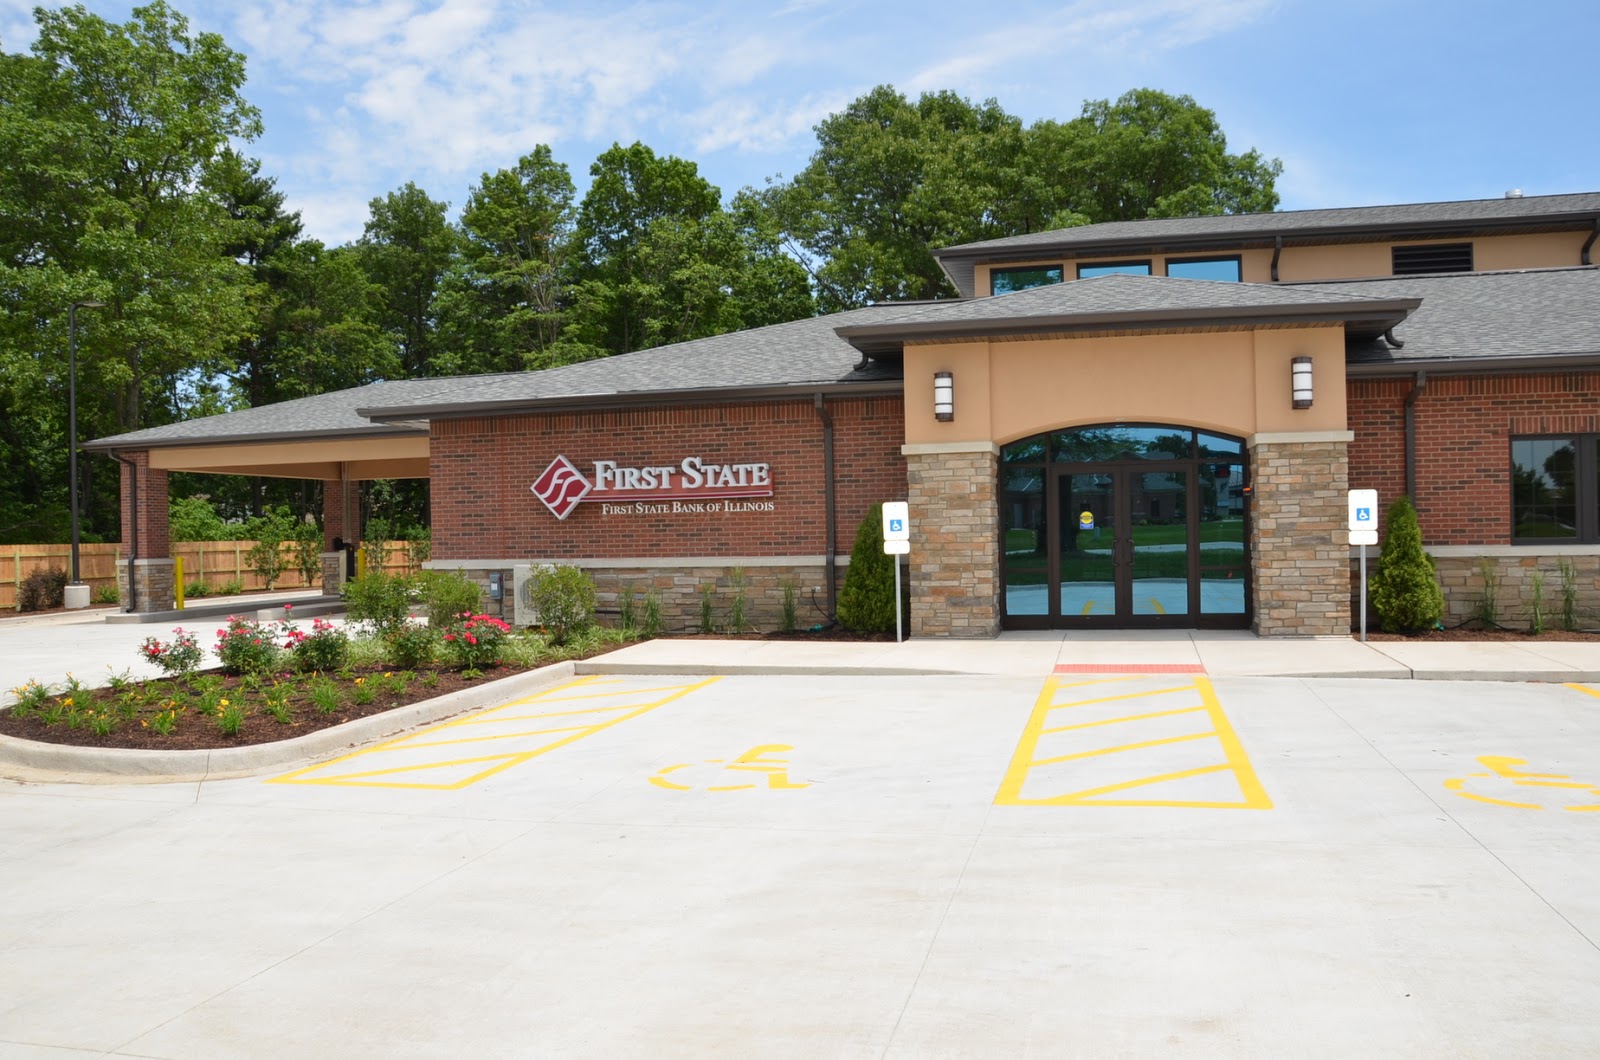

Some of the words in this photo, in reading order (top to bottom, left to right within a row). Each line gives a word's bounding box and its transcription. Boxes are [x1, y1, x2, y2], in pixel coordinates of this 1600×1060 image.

[592, 460, 676, 491] FIRST
[681, 456, 771, 489] STATE
[601, 503, 634, 515] FIRST
[635, 502, 670, 514] STATE
[672, 501, 705, 513] BANK
[706, 502, 722, 513] OF
[723, 500, 775, 512] ILLINOIS
